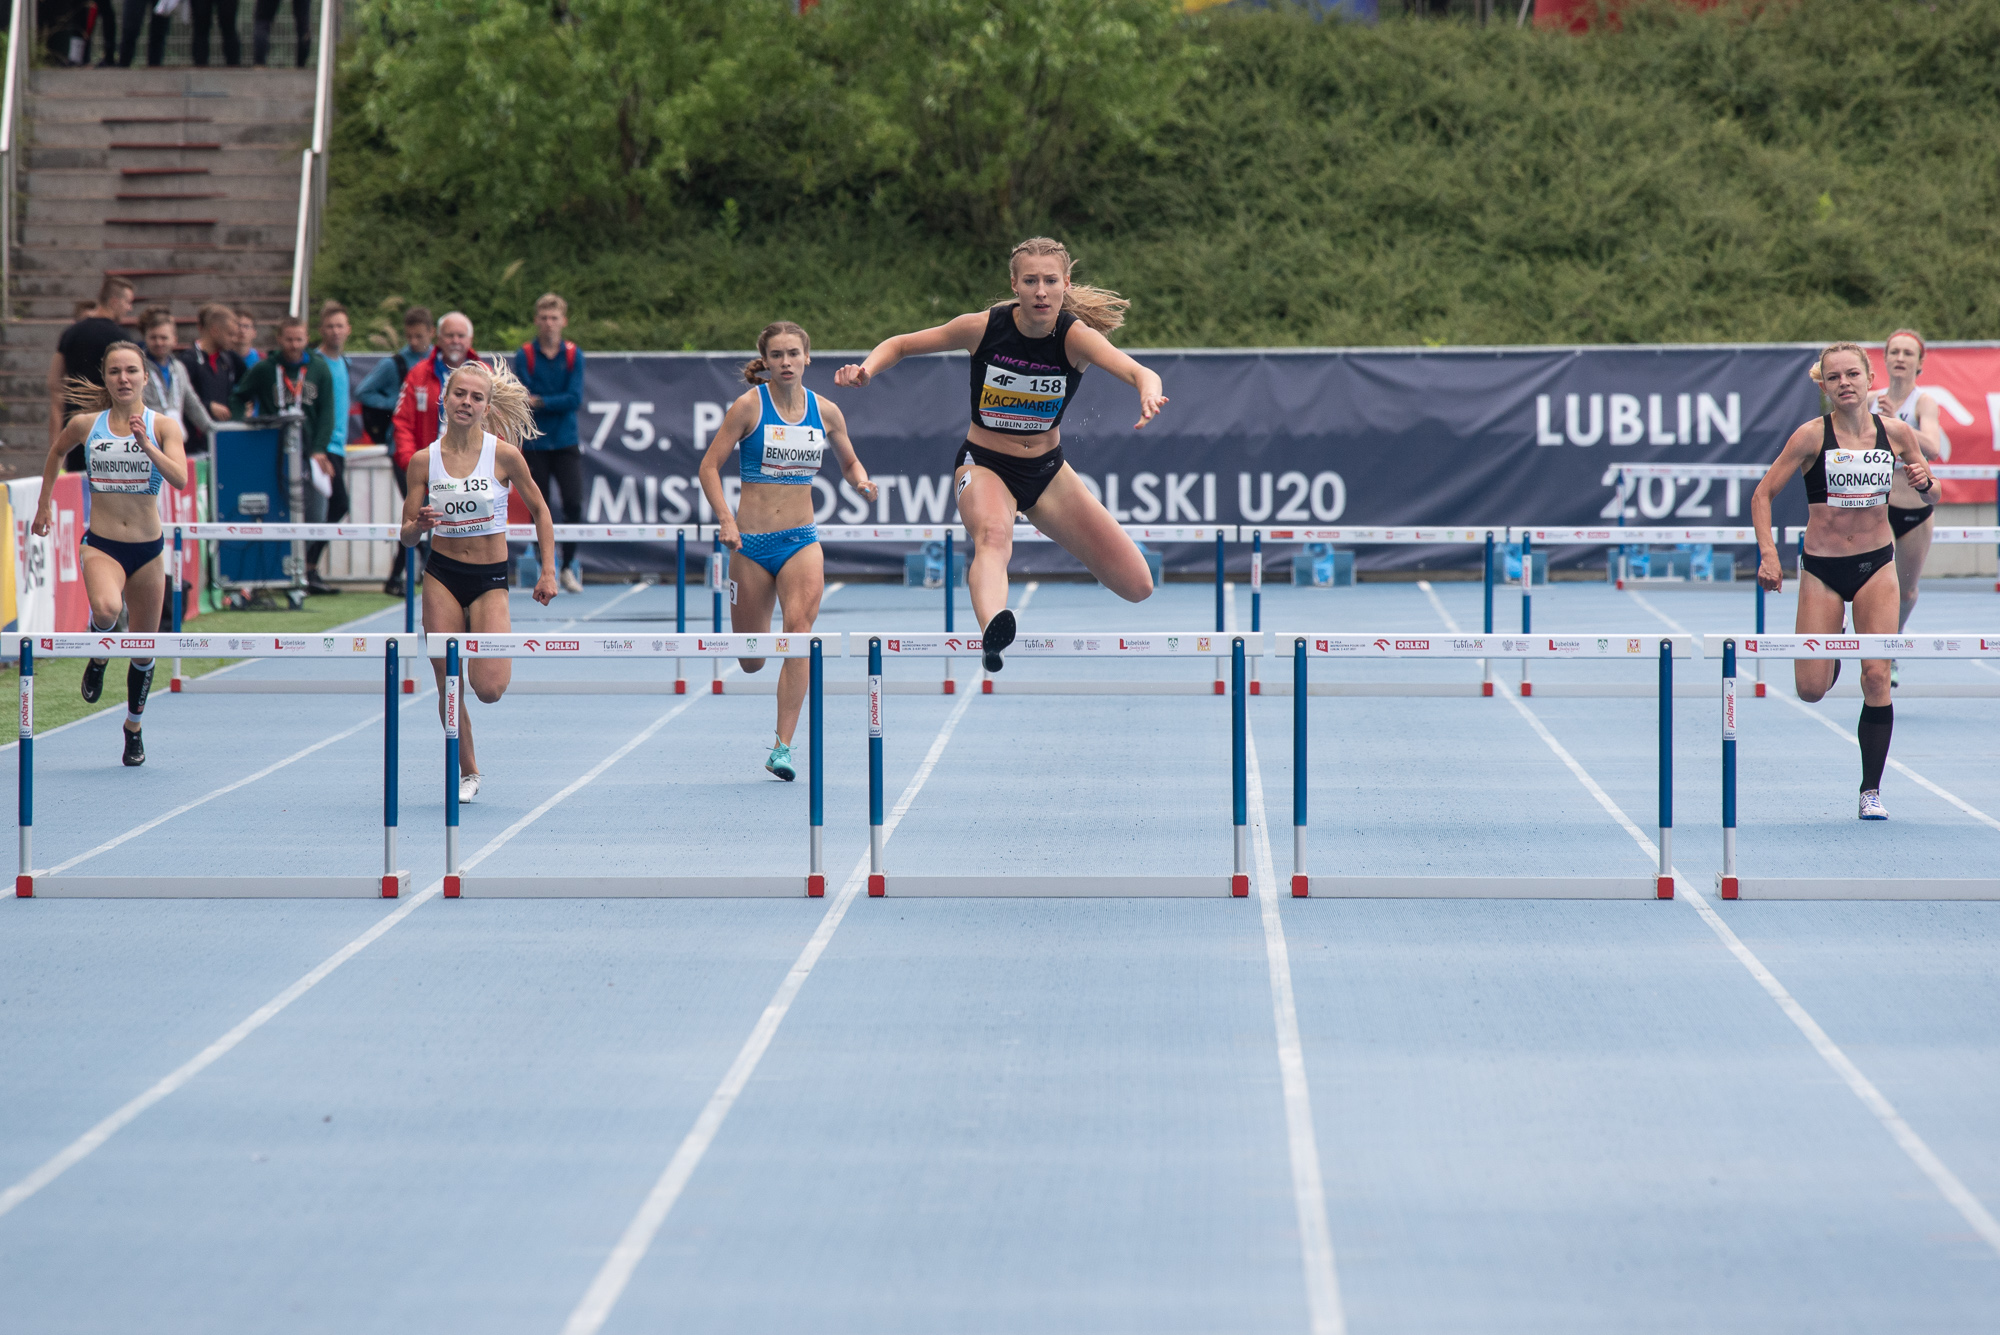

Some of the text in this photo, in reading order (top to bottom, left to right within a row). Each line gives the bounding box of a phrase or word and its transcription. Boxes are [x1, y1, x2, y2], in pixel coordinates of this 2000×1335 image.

[993, 353, 1060, 374] NIKE PRO
[992, 374, 1017, 387] 4F
[1029, 379, 1062, 394] 158
[983, 392, 1060, 413] KACZMAREK
[587, 401, 672, 452] 75.
[995, 420, 1022, 429] LUBLIN
[1536, 392, 1741, 447] LUBLIN
[808, 430, 815, 442] 1
[123, 441, 145, 453] 16
[766, 447, 821, 462] BENKOWSKA
[1863, 451, 1891, 464] 662
[91, 458, 150, 473] ŚWIRBUTOWICZ
[463, 479, 488, 493] 135
[1828, 472, 1891, 487] KORNACKA
[587, 474, 964, 524] MISTOSTW
[1238, 470, 1347, 522] U20
[1600, 463, 1741, 519] 2021
[445, 500, 477, 515] OKO
[468, 524, 484, 532] 2021
[729, 582, 735, 602] 6
[122, 640, 153, 648] ORLEN
[547, 642, 578, 650] ORLEN
[1397, 641, 1428, 649] ORLEN
[1827, 641, 1858, 649] ORLEN
[21, 691, 30, 727] polanik
[447, 692, 456, 727] polanik
[870, 691, 880, 726] polanik
[1726, 693, 1735, 729] polanik
